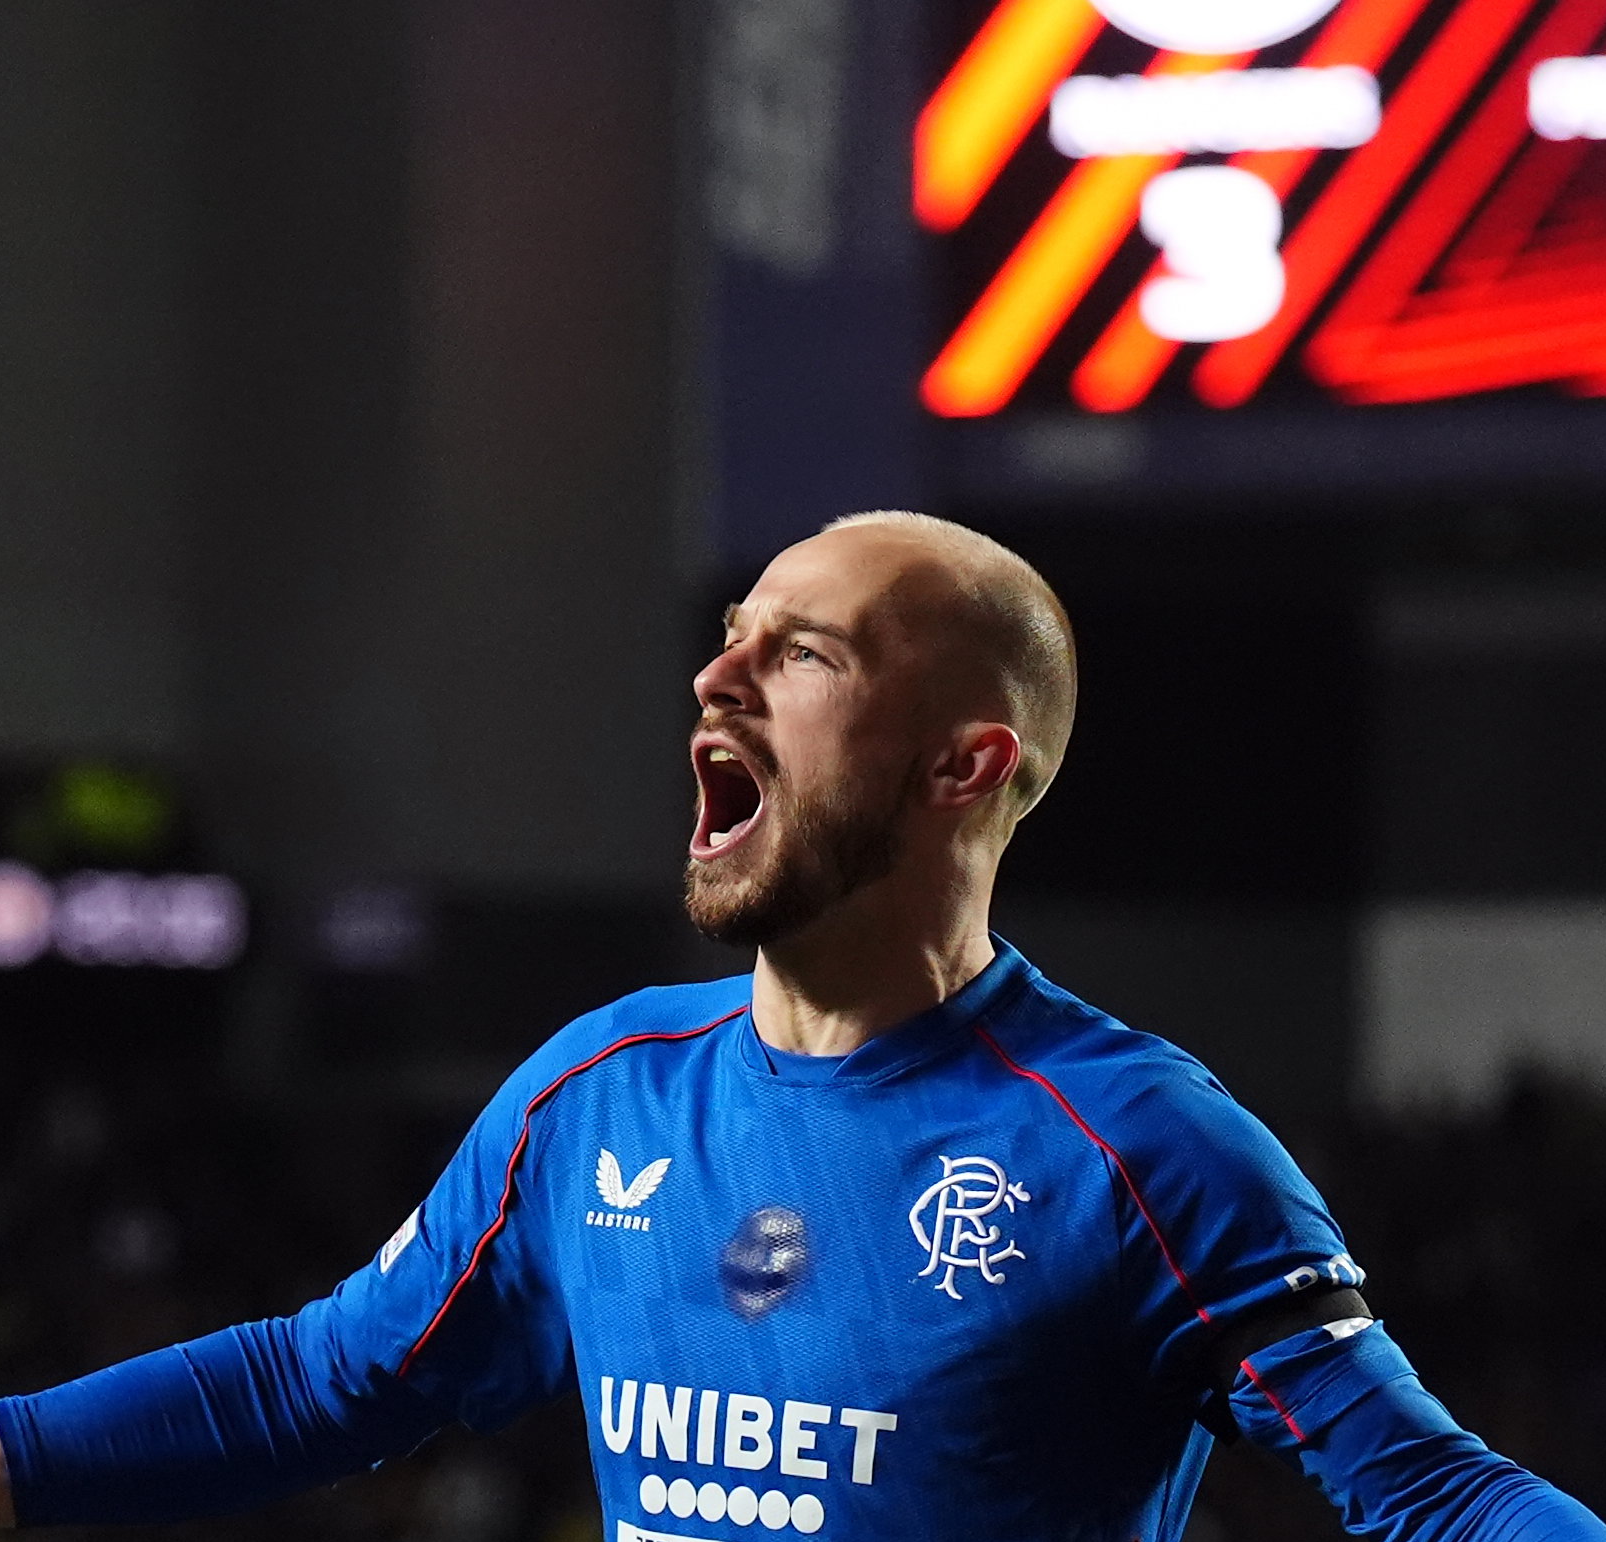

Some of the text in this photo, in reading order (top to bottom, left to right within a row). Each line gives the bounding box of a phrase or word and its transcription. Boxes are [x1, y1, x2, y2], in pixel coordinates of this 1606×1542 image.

[1138, 166, 1284, 341] 3
[585, 1210, 651, 1231] CASTORE
[600, 1377, 897, 1485] UNIBET
